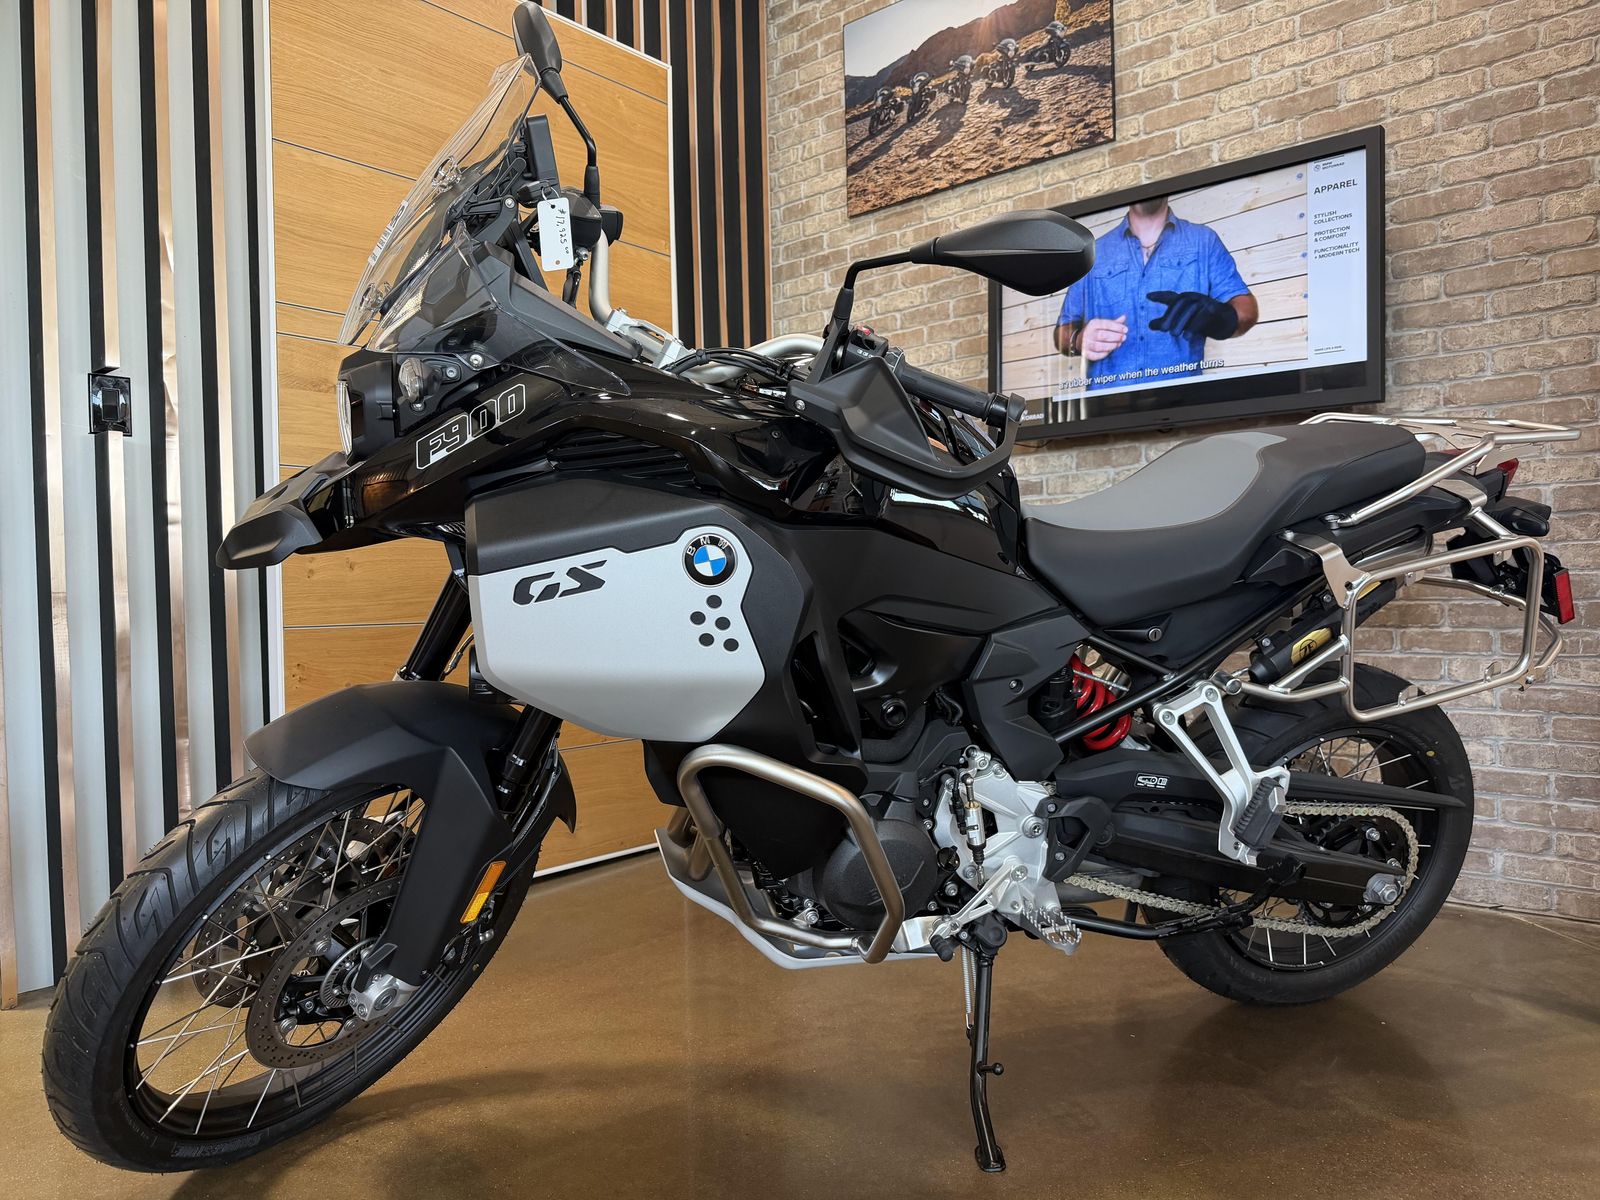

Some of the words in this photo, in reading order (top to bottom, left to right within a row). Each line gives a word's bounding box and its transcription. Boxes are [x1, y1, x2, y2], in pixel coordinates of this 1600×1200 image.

[1313, 179, 1358, 195] APPAREL
[1313, 210, 1337, 219] STYLISH
[1313, 213, 1353, 225] COLLECTIONS
[1314, 225, 1351, 237] PROTECTION
[1318, 232, 1347, 242] COMFORT
[1314, 241, 1359, 254] FUNCTIONALITY
[1318, 250, 1344, 260] MODERN
[1344, 247, 1360, 255] TECH
[1065, 377, 1092, 388] rubber
[1093, 374, 1117, 385] wiper
[1118, 369, 1143, 380] when
[1144, 367, 1159, 377] the
[1160, 362, 1198, 375] weather
[1199, 359, 1224, 369] turns
[416, 383, 526, 470] F900
[686, 534, 729, 557] BMW
[512, 559, 608, 606] GS
